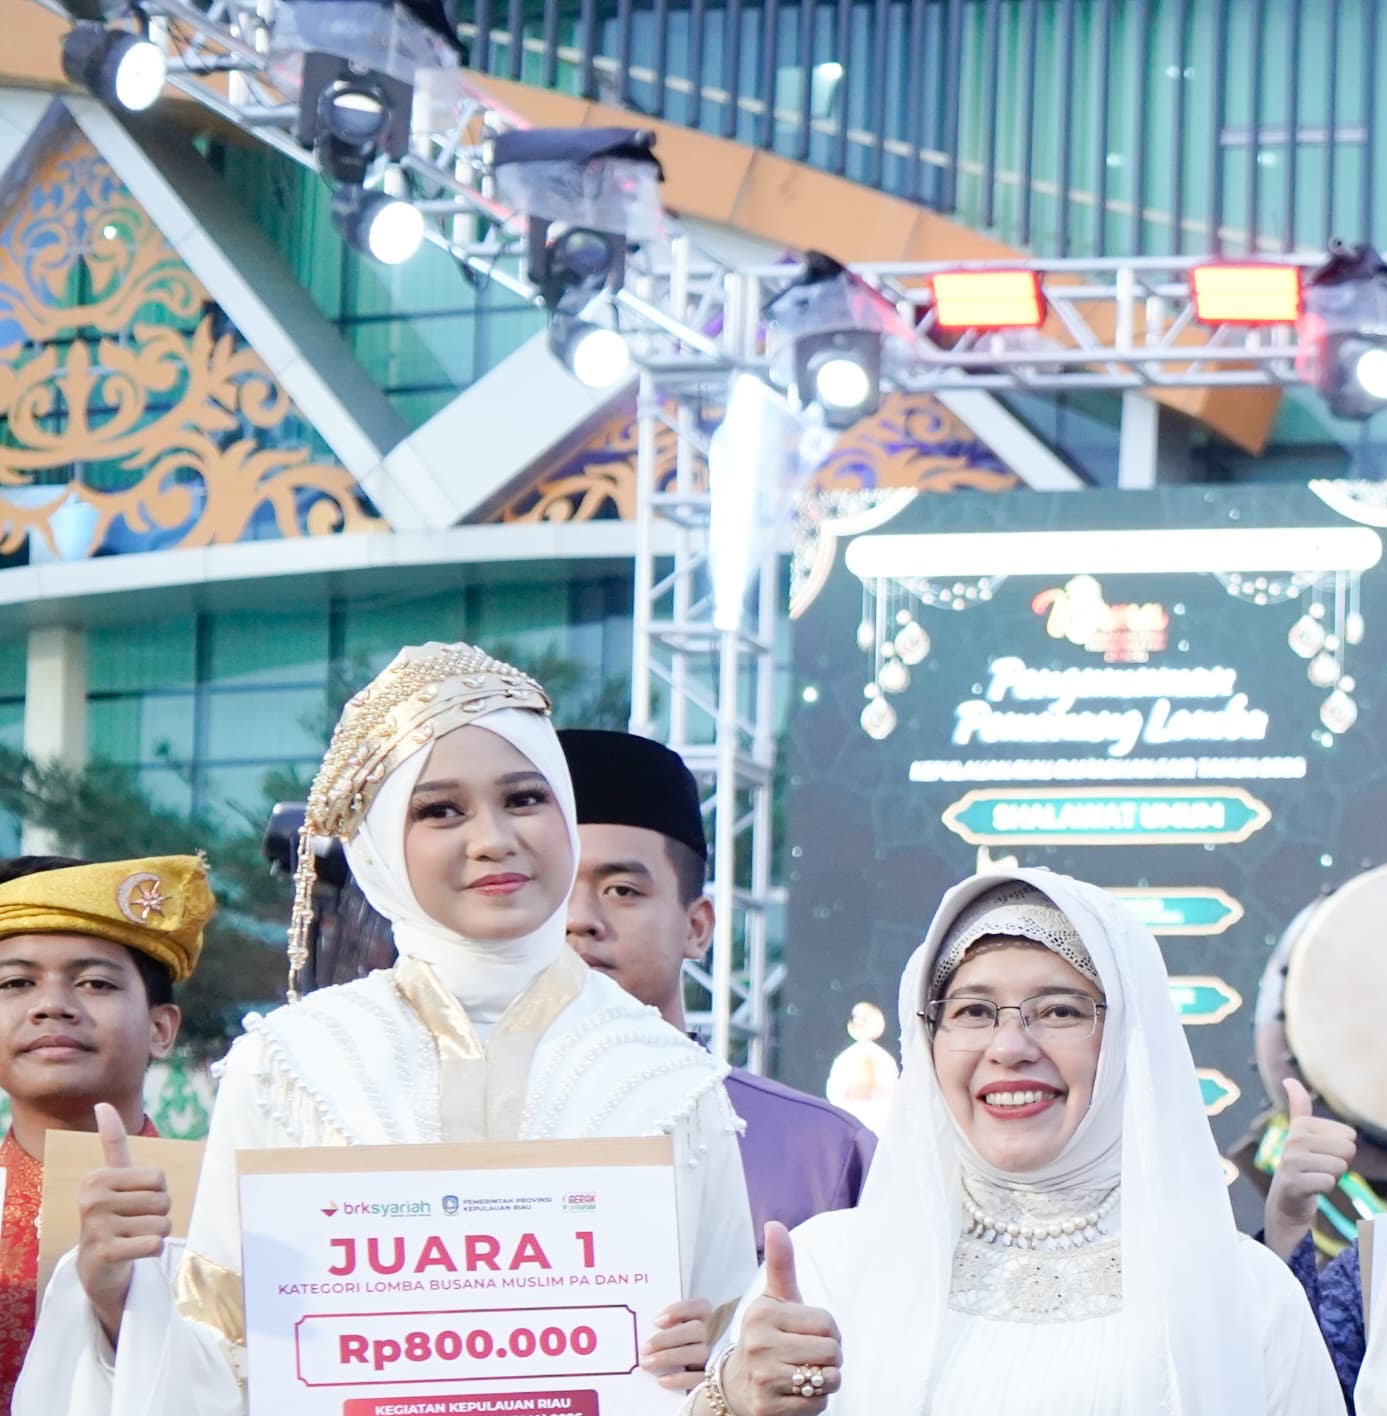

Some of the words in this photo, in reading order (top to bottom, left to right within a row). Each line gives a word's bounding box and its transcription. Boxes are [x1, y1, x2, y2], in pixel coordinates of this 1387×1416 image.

[344, 1200, 431, 1217] brksyariah
[328, 1233, 552, 1276] JUARA
[575, 1231, 595, 1268] 1
[278, 1282, 361, 1295] KATEGORI
[366, 1280, 424, 1293] LOMBA
[430, 1278, 496, 1290] BUSANA
[502, 1275, 564, 1288] MUSLIM
[570, 1275, 590, 1286] PA
[595, 1274, 629, 1285] DAN
[634, 1273, 648, 1284] PI
[339, 1325, 597, 1371] Rp800.000
[375, 1403, 446, 1416] KEGIATAN
[449, 1399, 534, 1413] KEPULAUAN
[538, 1398, 571, 1409] RIAU
